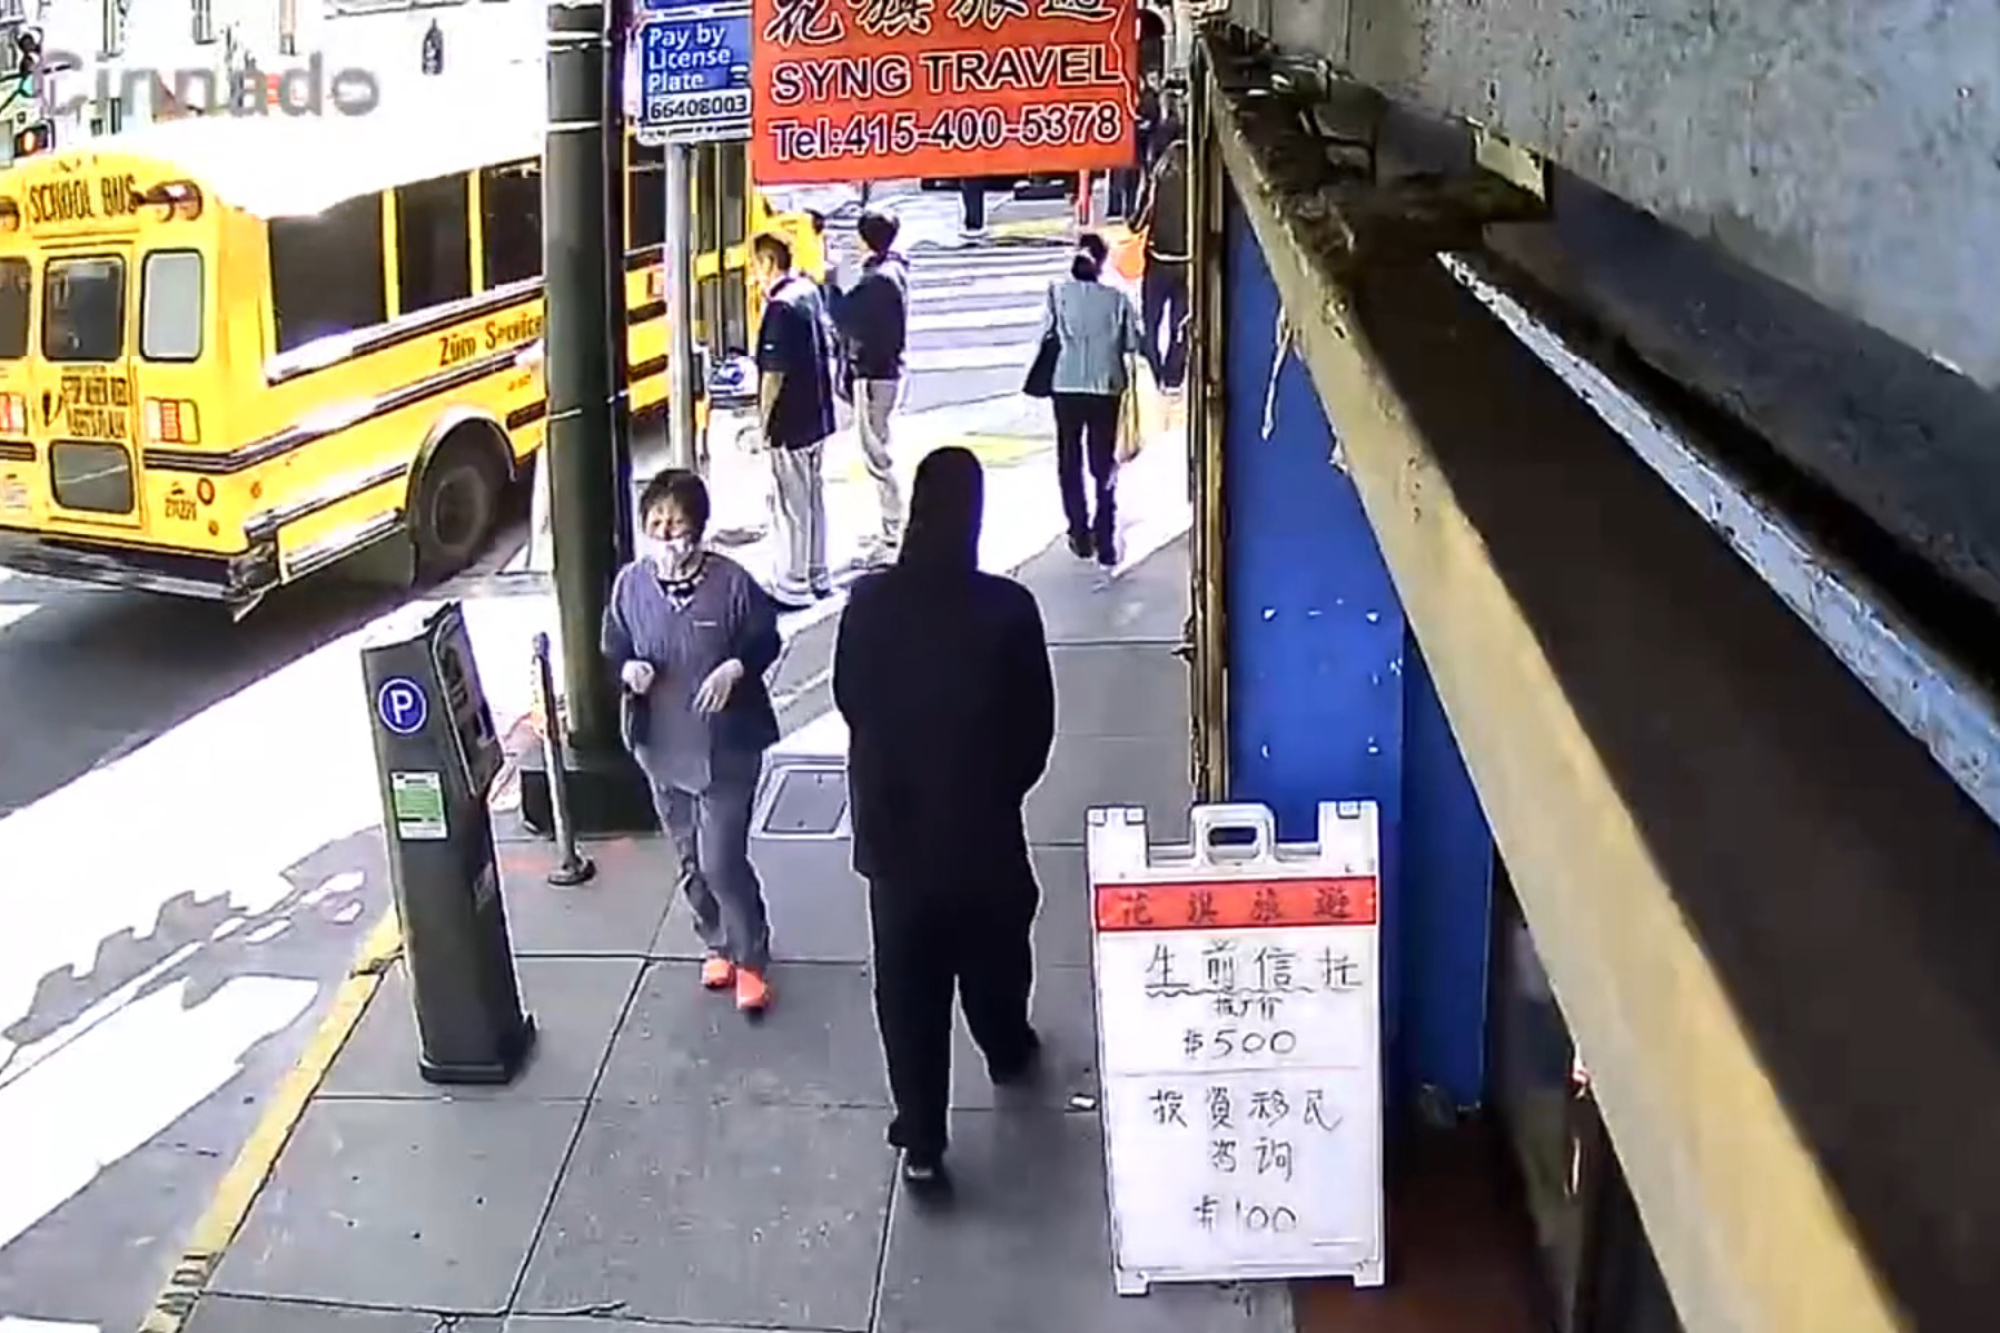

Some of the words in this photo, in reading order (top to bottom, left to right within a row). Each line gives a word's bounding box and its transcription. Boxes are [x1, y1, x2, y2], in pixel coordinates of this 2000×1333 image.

[649, 26, 691, 50] Pay
[696, 22, 726, 48] by
[649, 48, 732, 71] License
[771, 55, 911, 104] SYNG
[920, 44, 1123, 92] TRAVEL
[648, 71, 705, 94] Plate
[30, 180, 95, 223] SCHOOL
[101, 174, 138, 216] BUS
[390, 689, 414, 723] P
[1183, 1029, 1297, 1059] $500
[1193, 1194, 1297, 1234] $100
